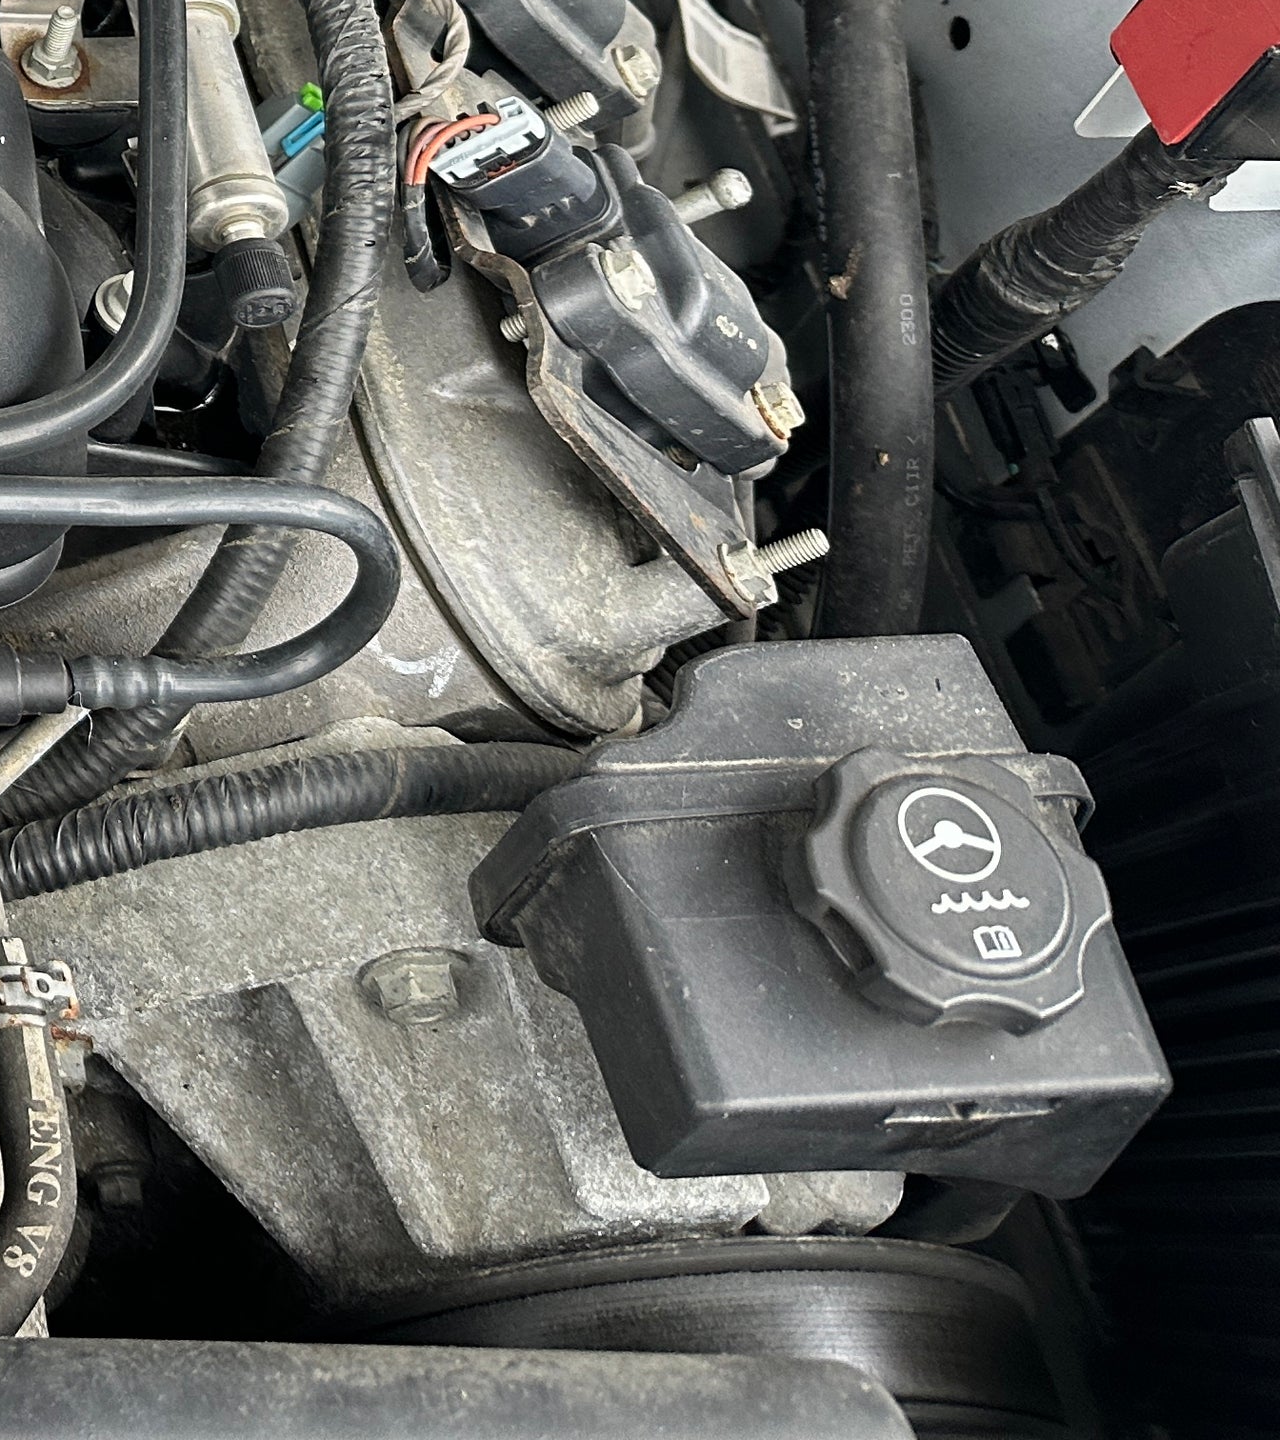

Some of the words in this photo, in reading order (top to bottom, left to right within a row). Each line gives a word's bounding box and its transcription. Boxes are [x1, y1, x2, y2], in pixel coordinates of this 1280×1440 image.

[899, 293, 916, 347] 2300
[27, 1107, 63, 1209] ENG
[3, 1224, 54, 1279] V8
